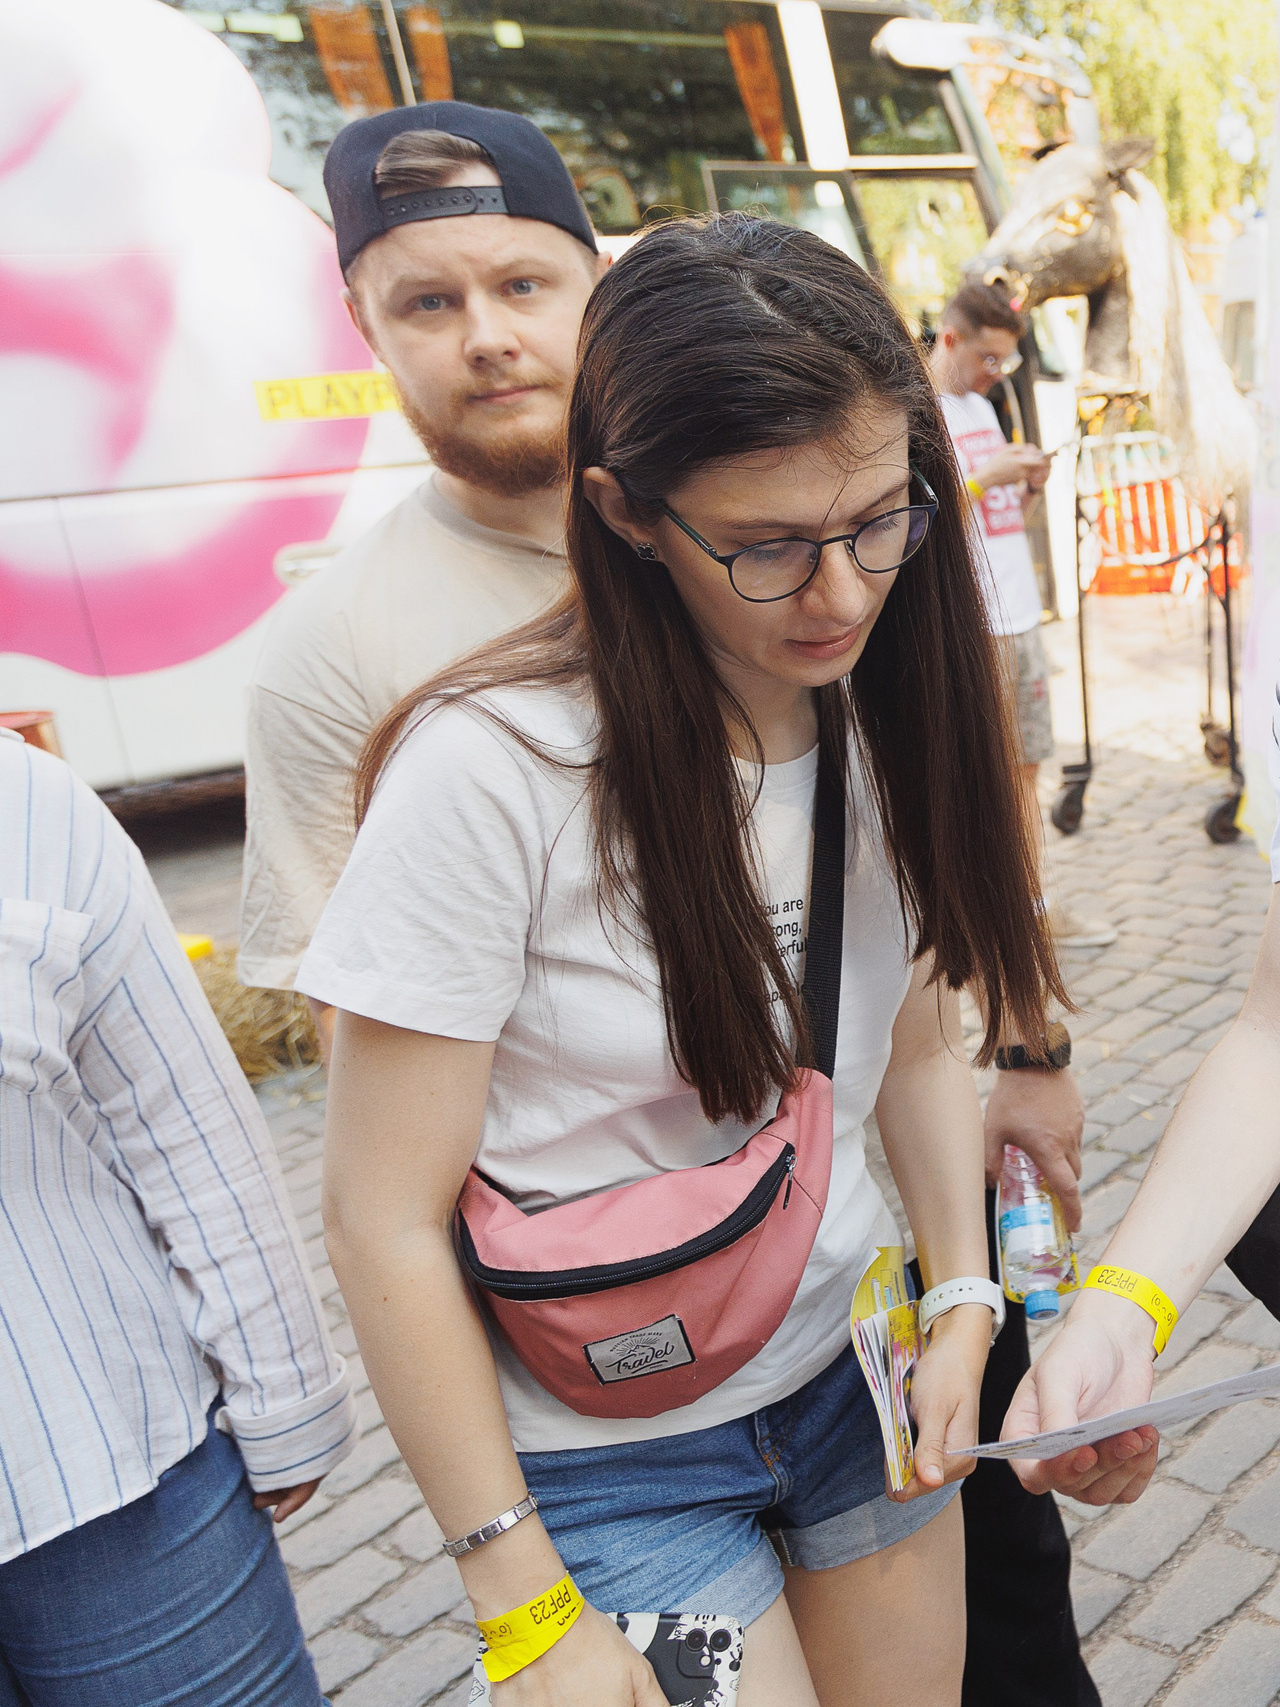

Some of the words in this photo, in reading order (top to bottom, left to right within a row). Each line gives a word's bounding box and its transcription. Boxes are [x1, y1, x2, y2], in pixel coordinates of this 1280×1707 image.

[764, 902, 779, 916] ou
[782, 899, 804, 913] are
[1097, 1268, 1139, 1293] PPF23
[605, 1341, 675, 1374] Travel
[529, 1583, 573, 1625] PPF23
